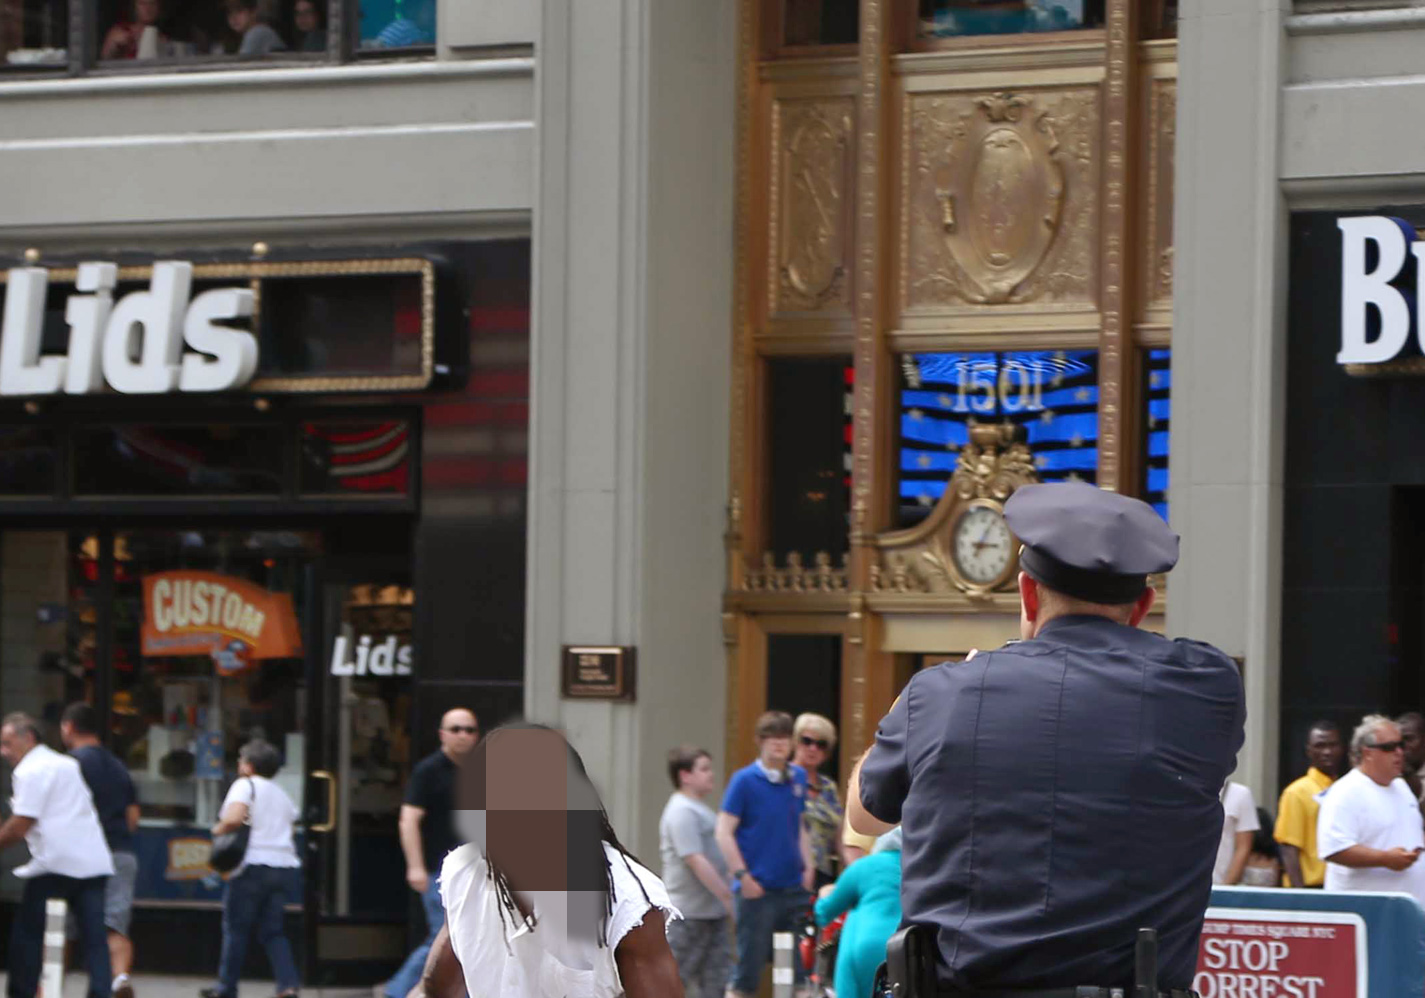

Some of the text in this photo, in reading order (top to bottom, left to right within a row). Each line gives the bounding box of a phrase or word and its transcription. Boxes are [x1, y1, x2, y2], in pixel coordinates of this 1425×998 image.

[0, 260, 259, 395] Lids
[952, 359, 1046, 413] 1501
[152, 578, 266, 638] CUSTOM
[330, 634, 412, 677] Lids
[1204, 937, 1290, 972] STOP
